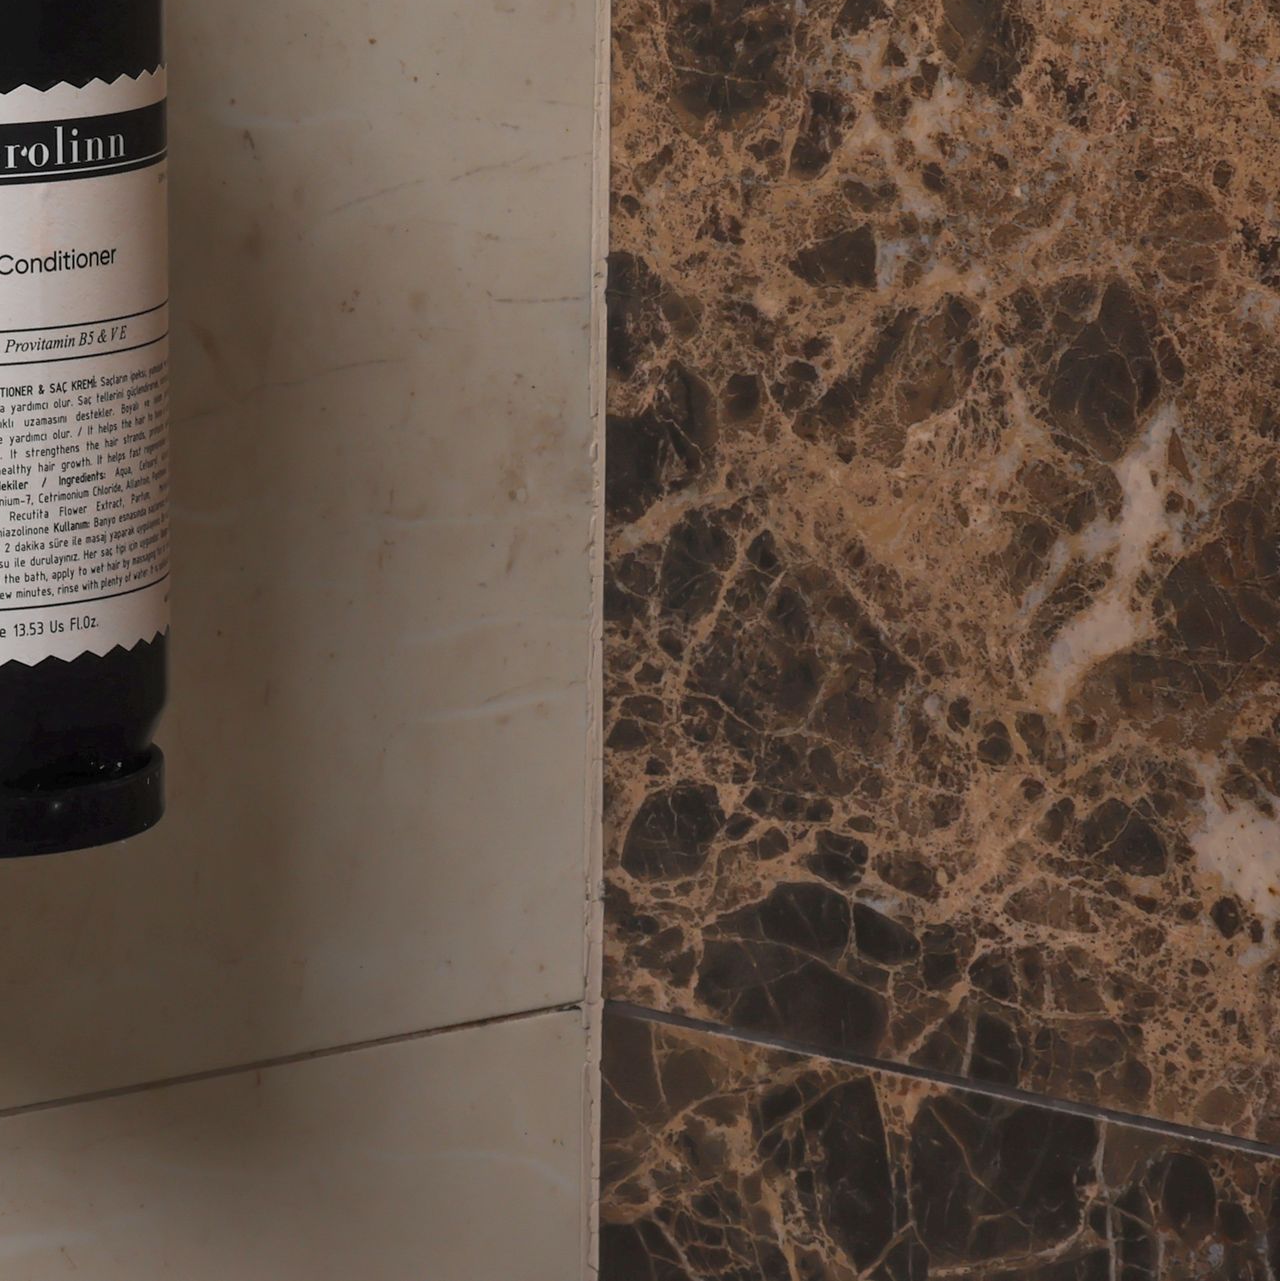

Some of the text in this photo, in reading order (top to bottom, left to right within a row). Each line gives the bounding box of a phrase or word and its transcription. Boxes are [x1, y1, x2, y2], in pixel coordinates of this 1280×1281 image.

[4, 335, 76, 354] Provitamin
[78, 330, 95, 347] B5
[96, 328, 108, 344] &
[38, 383, 46, 396] &
[49, 381, 68, 394] SAÇ
[10, 448, 18, 460] It
[25, 444, 80, 459] strengthens
[37, 461, 56, 473] hair
[38, 488, 90, 504] Cetrimonium
[9, 508, 49, 522] Recutita
[59, 505, 88, 517] Flower
[4, 573, 21, 584] the
[0, 627, 7, 639] e
[13, 621, 44, 638] 13.53
[49, 619, 65, 634] Us
[70, 615, 99, 632] Fl.Oz.
